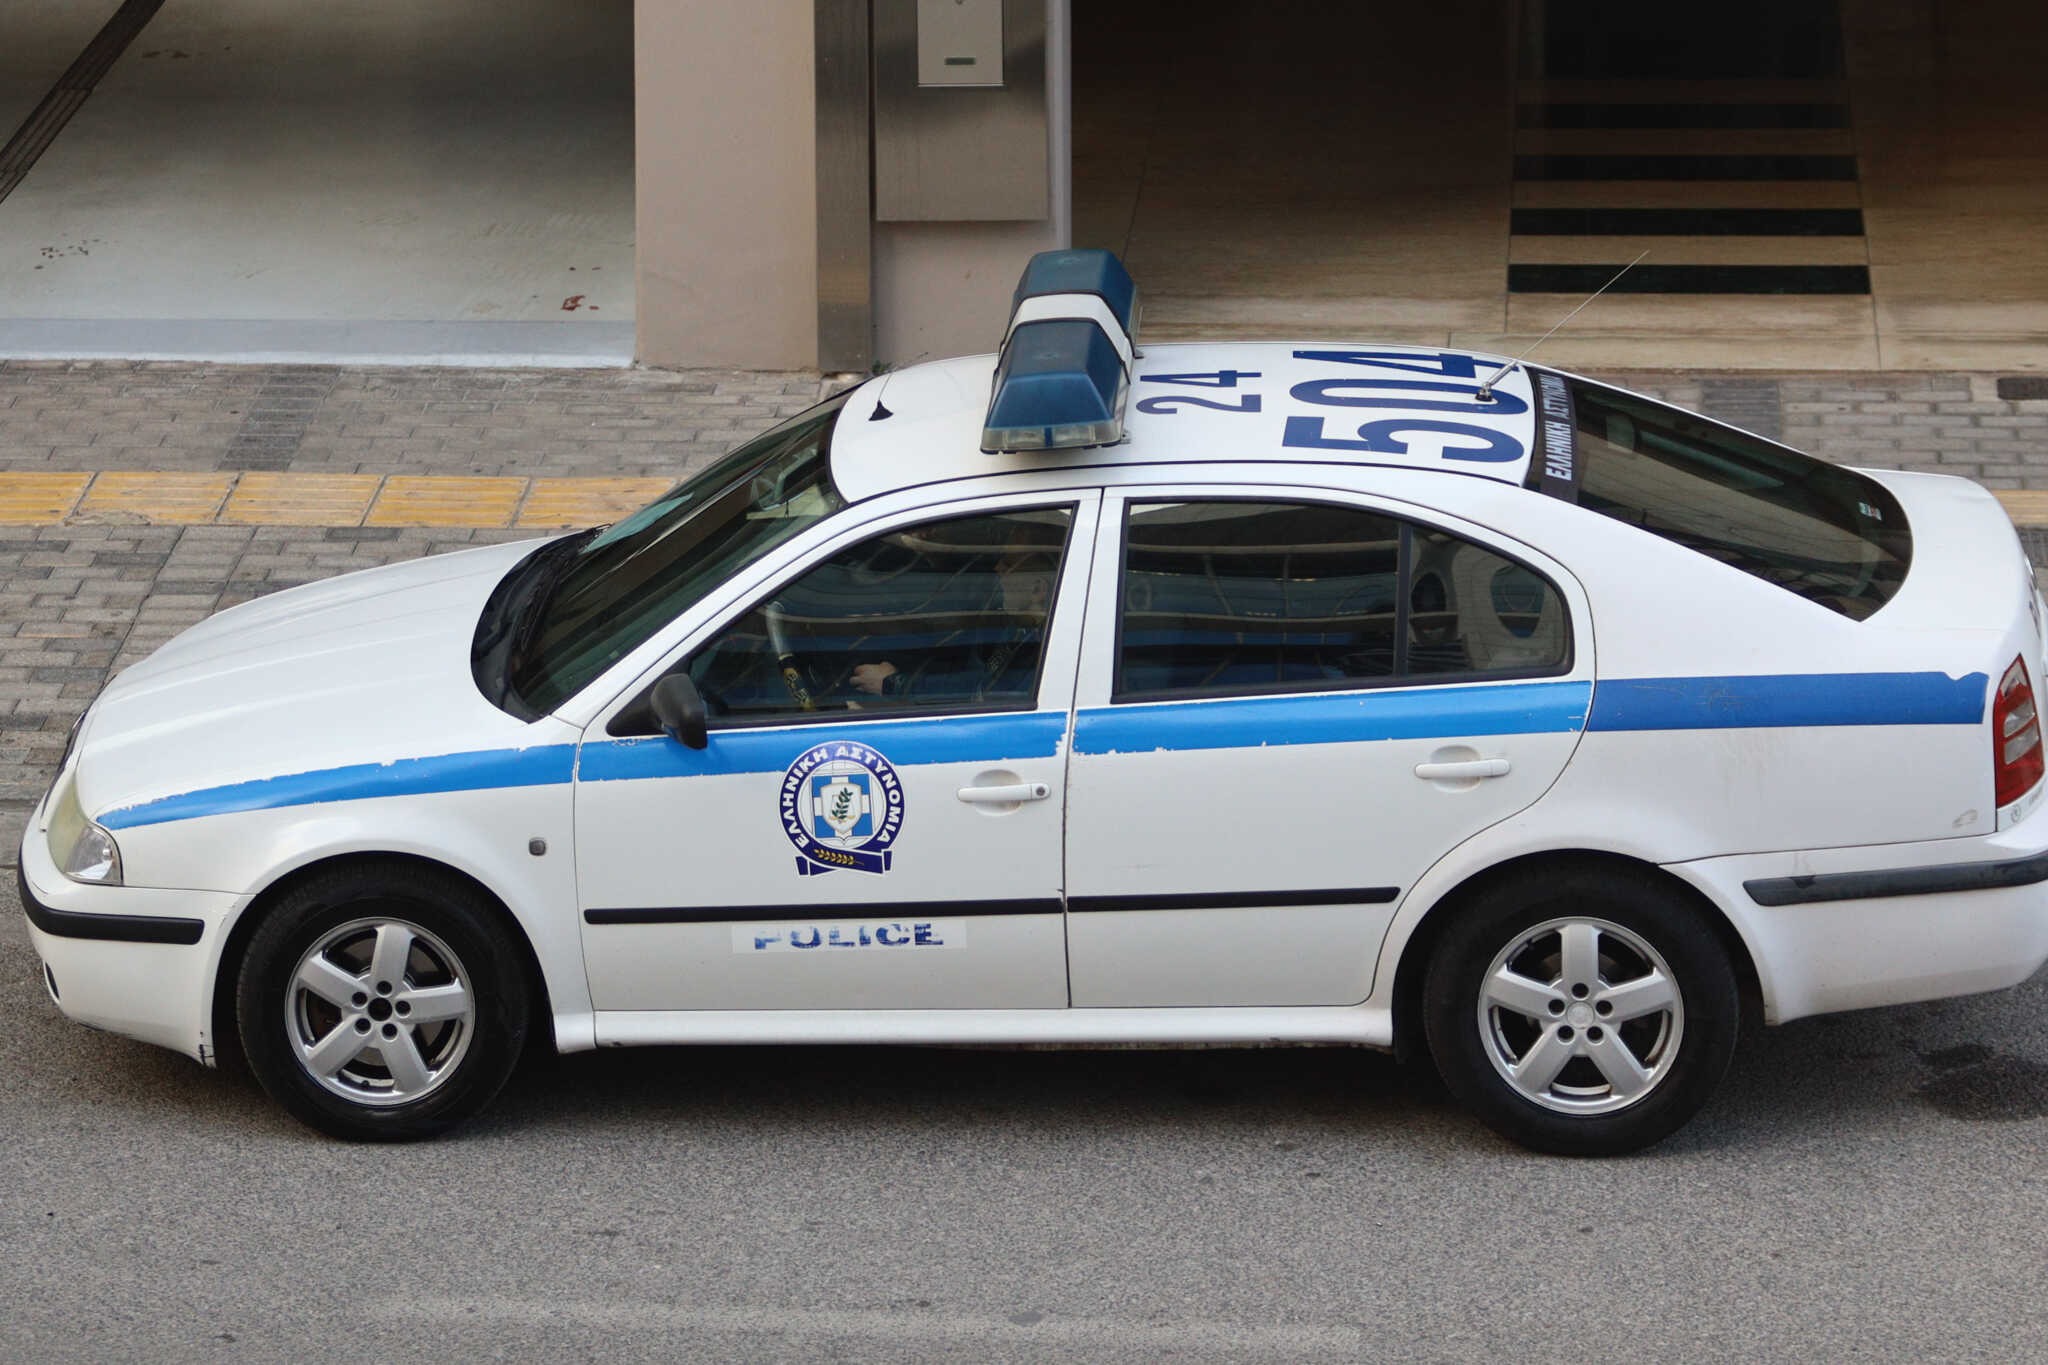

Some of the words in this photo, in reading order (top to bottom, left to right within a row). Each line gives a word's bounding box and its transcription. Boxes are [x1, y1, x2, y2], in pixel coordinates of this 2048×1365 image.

[1136, 369, 1262, 415] 24
[1282, 349, 1529, 464] 504
[1544, 420, 1572, 481] ΕΛΛΗΝΙΚΗ
[782, 748, 828, 849] ΕΛΛΗΝΙΚΗ
[835, 745, 901, 843] ΑΣΤΥΝΟΜΙΑ
